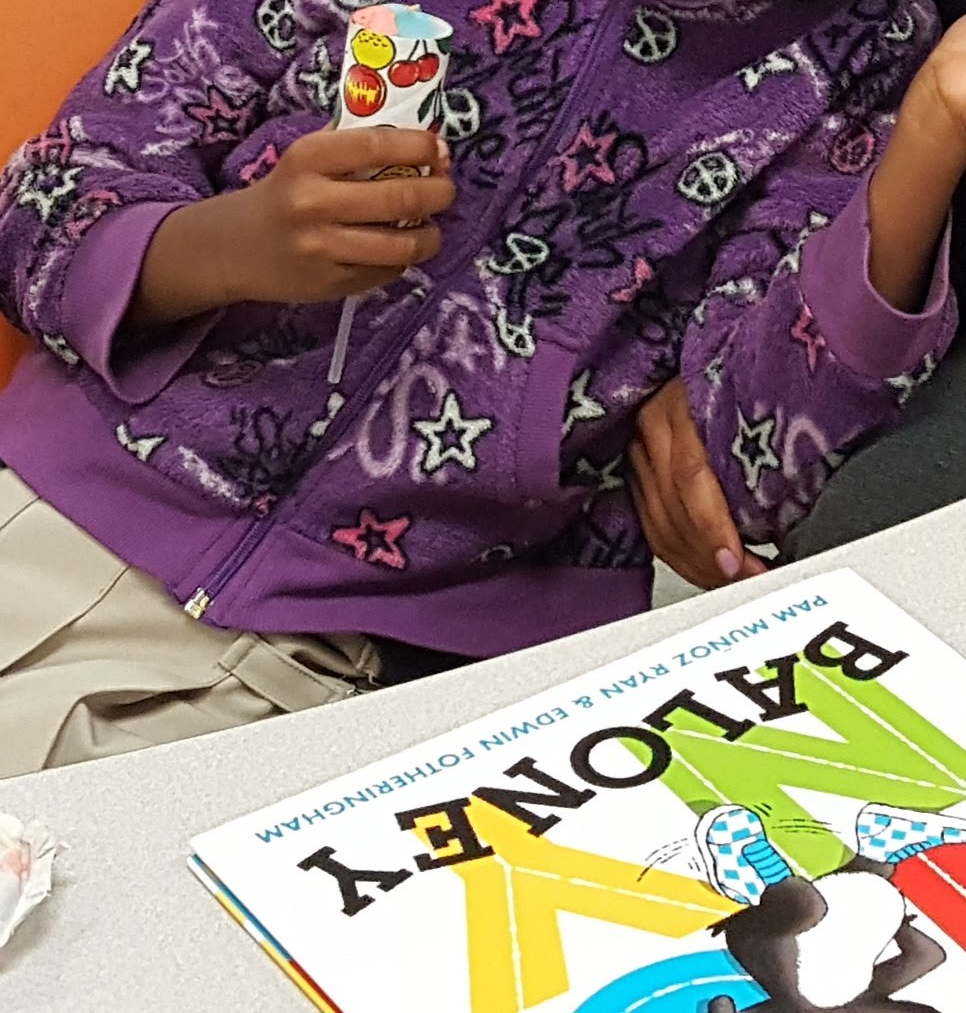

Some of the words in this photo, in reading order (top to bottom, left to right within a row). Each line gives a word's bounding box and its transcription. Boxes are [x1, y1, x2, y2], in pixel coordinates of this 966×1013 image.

[772, 594, 829, 624] PAM
[672, 618, 769, 668] MUÑOZ
[574, 695, 596, 712] &
[600, 663, 671, 700] RYAN
[479, 707, 570, 754] EDWIN
[297, 621, 910, 918] BALONEY
[255, 747, 476, 845] FOTHERINGHAM
